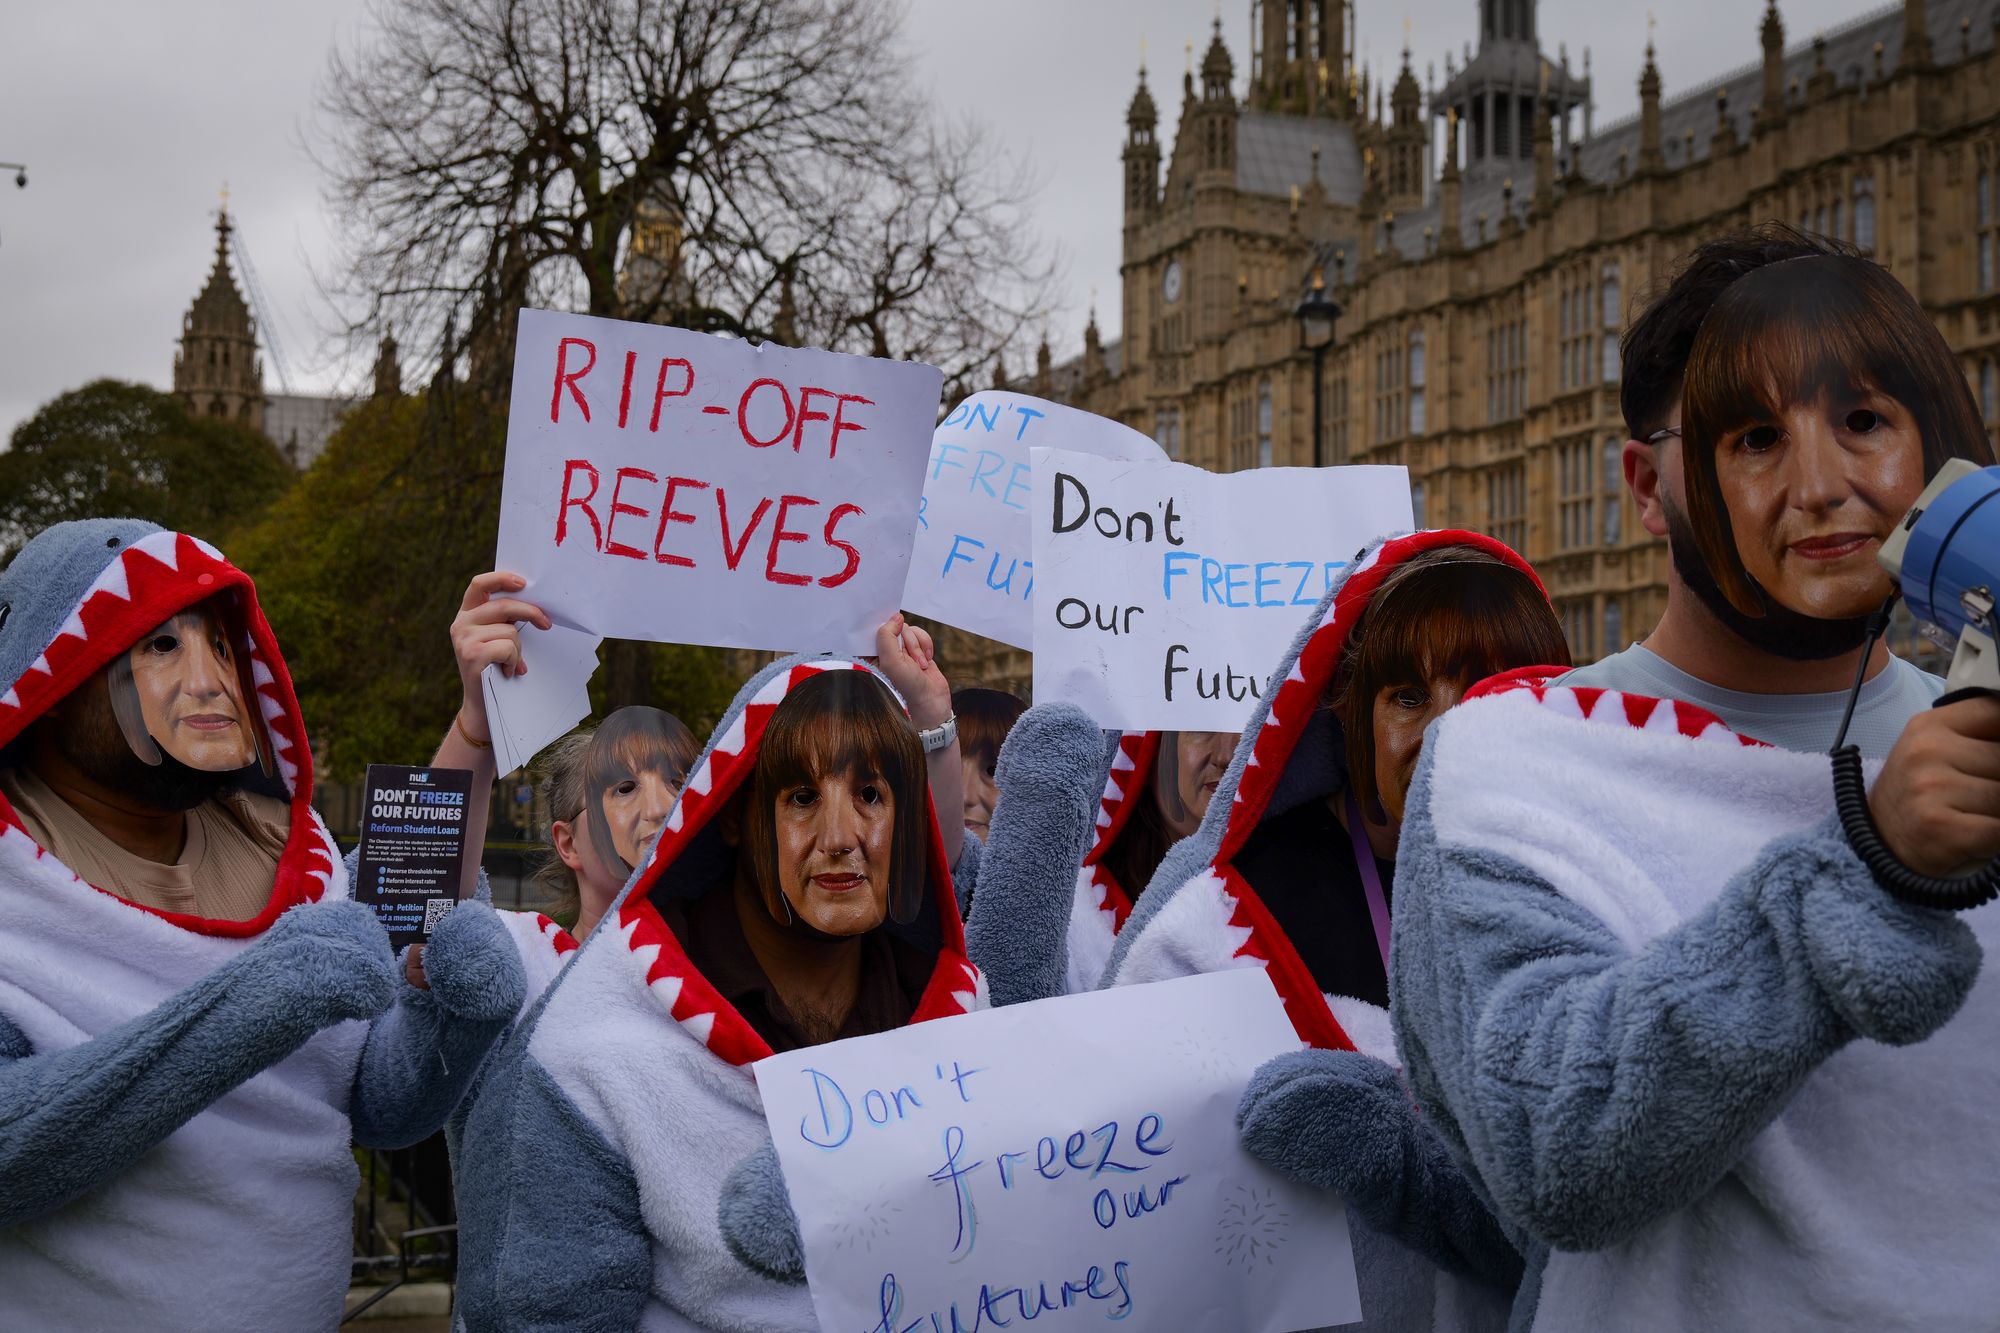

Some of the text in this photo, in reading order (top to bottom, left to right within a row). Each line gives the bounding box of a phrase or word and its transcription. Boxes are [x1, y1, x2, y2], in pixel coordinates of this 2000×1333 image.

[550, 337, 876, 460] RIP-OFF
[945, 403, 1045, 440] ON'T
[930, 444, 1031, 509] FRE
[554, 459, 866, 589] REEVES
[1052, 472, 1184, 546] Don't
[1056, 598, 1144, 636] our
[409, 773, 429, 782] nus
[372, 804, 462, 820] OUR FUTURES
[373, 789, 464, 805] DON'T FREEZE
[370, 823, 460, 835] Reform Student Loans
[381, 903, 394, 911] the
[393, 915, 422, 923] message
[800, 1062, 988, 1150] Don't
[928, 1111, 1178, 1264] freeze
[1093, 1174, 1190, 1229] our
